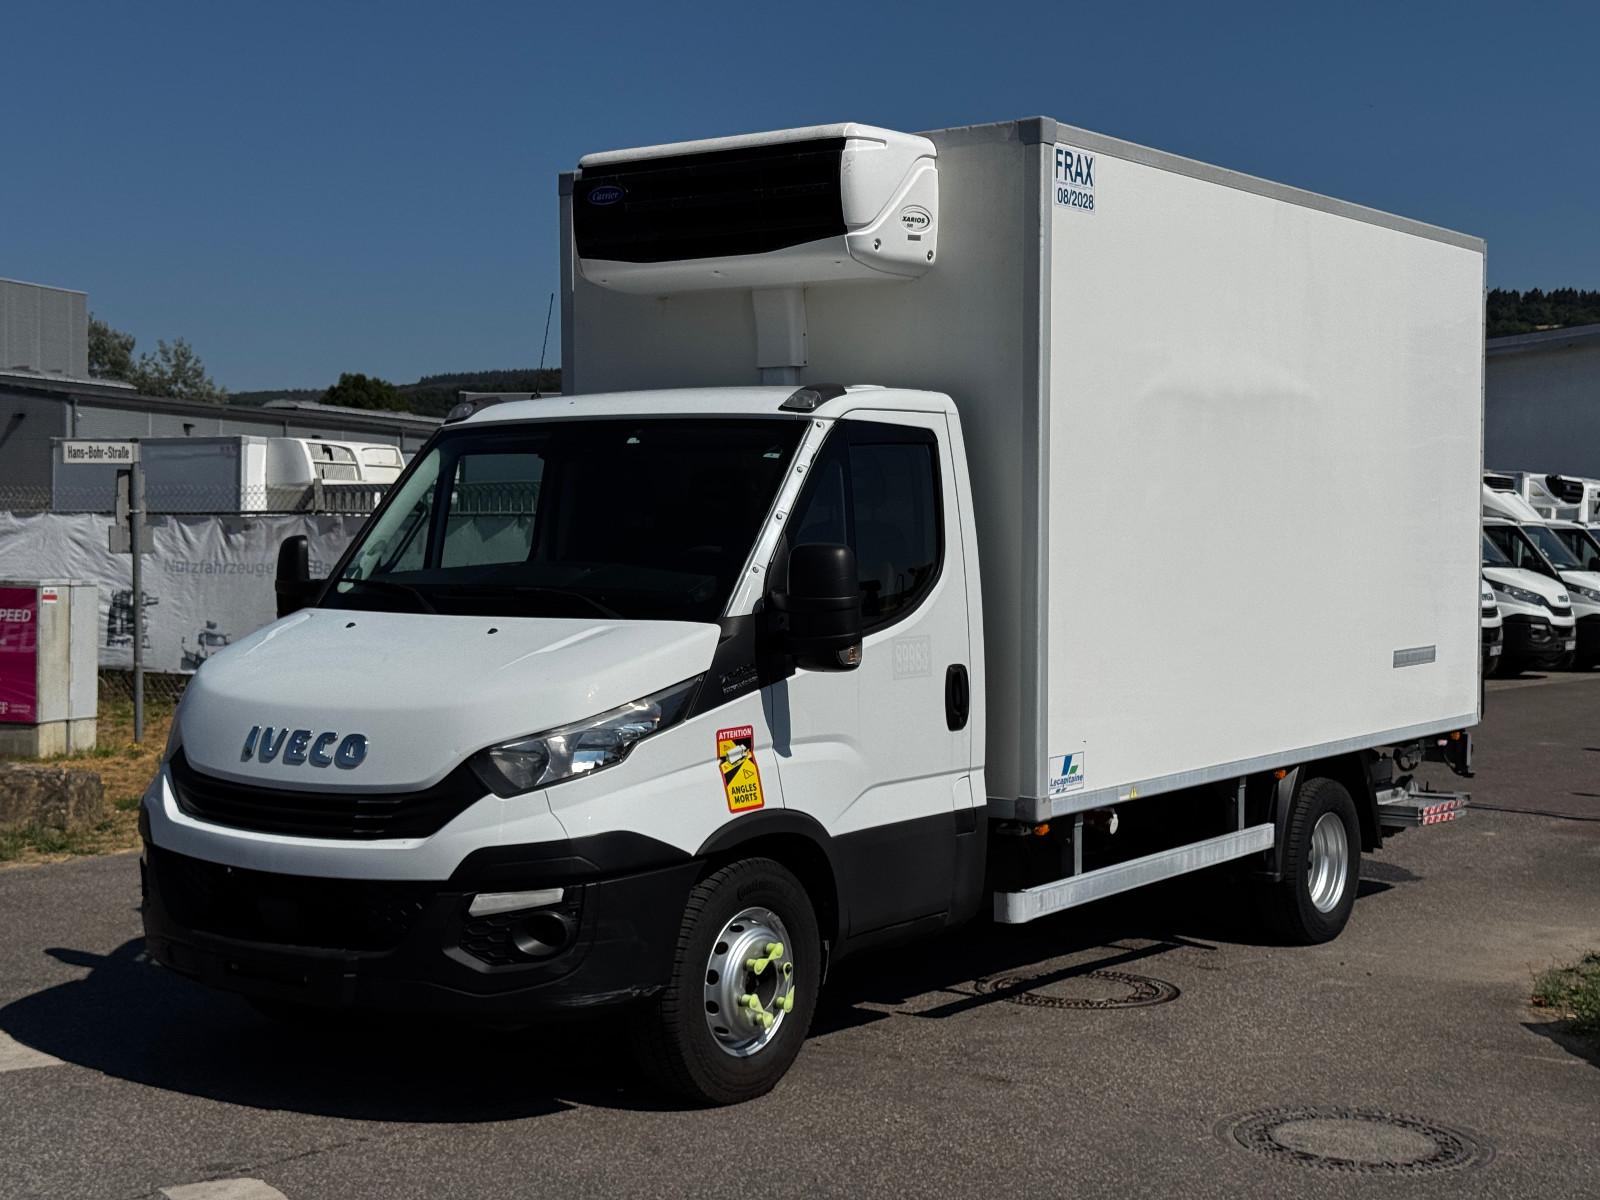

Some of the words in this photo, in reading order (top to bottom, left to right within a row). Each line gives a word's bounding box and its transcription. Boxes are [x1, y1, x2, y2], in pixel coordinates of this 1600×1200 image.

[1055, 149, 1094, 187] FRAX
[1057, 187, 1094, 210] 08/2028
[901, 215, 926, 224] XARIOS
[67, 445, 130, 459] Hans-Bohr-Straße
[718, 727, 752, 741] ATTENTION
[240, 726, 369, 770] IVECO
[731, 782, 758, 796] ANGLES
[734, 793, 758, 805] MORTS
